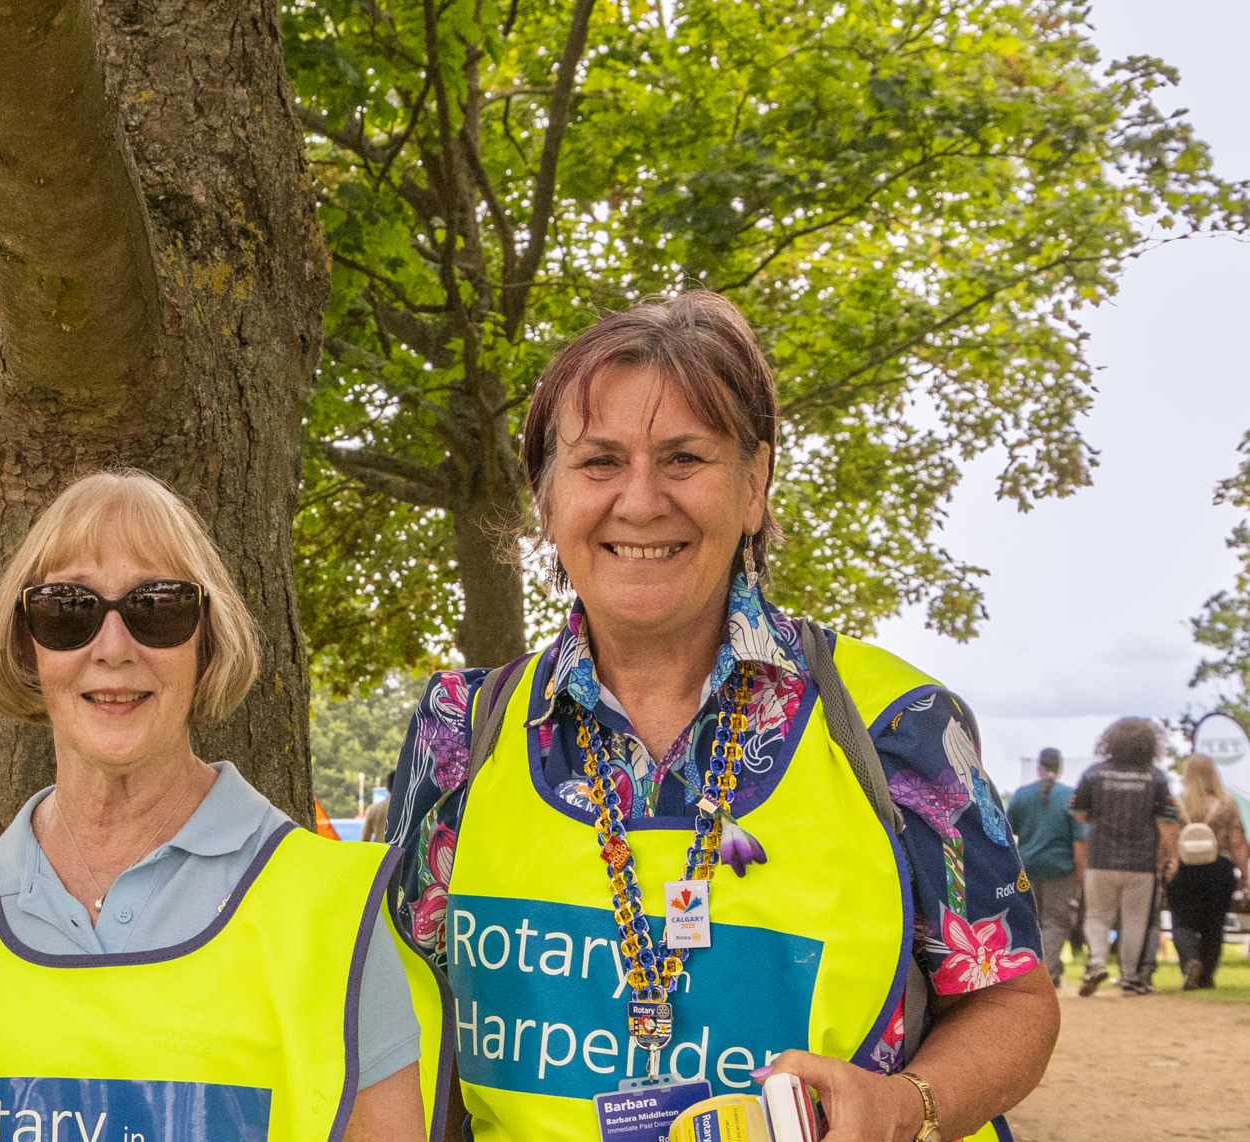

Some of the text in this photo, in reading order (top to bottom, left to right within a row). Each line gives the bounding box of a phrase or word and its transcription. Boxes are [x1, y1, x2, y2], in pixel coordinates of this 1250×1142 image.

[608, 844, 621, 860] END
[611, 844, 627, 867] POLIO
[615, 850, 630, 871] NOW
[671, 916, 704, 924] CALGARY
[633, 1006, 655, 1015] Rotary
[604, 1098, 657, 1113] Barbara
[606, 1110, 679, 1125] Barbara Middleton
[607, 1125, 638, 1134] Immediate
[702, 1114, 712, 1142] Rotary
